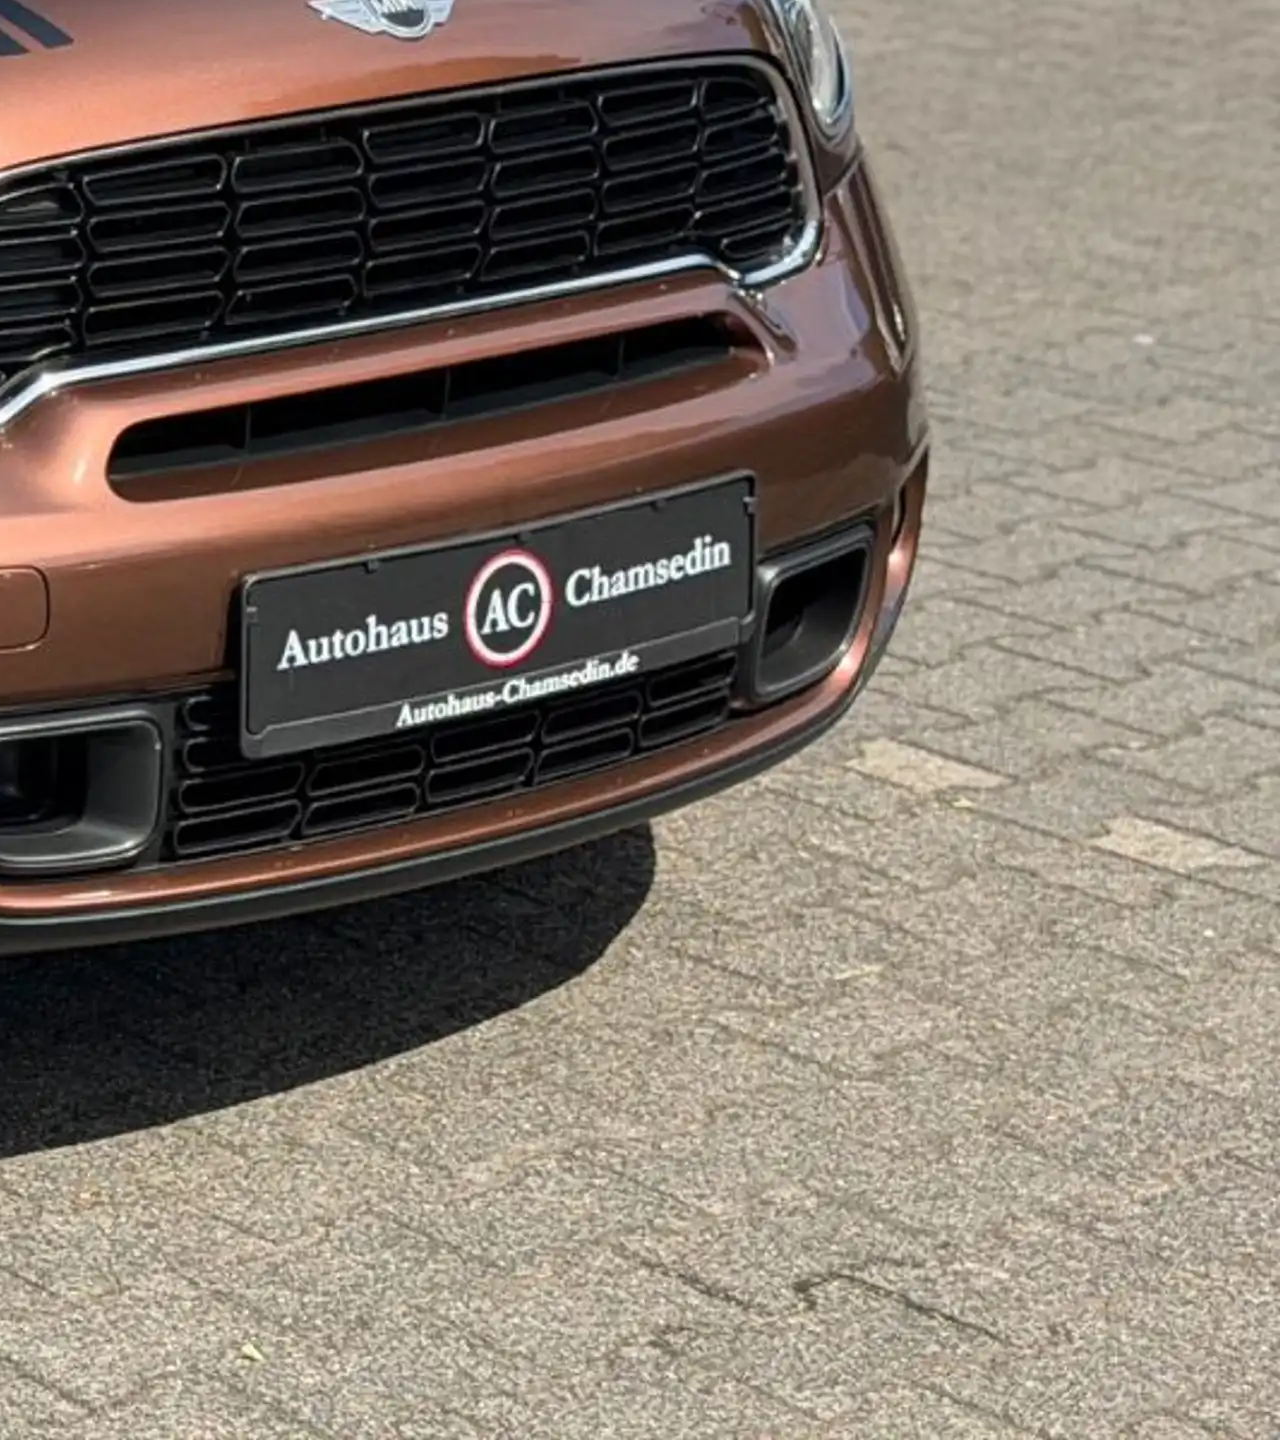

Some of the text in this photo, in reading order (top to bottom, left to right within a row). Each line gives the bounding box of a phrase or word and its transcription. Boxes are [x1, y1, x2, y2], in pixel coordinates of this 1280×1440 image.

[276, 534, 732, 671] Autohaus AC Chamsedin
[395, 649, 640, 729] Autohaus-Chamsedin.de
